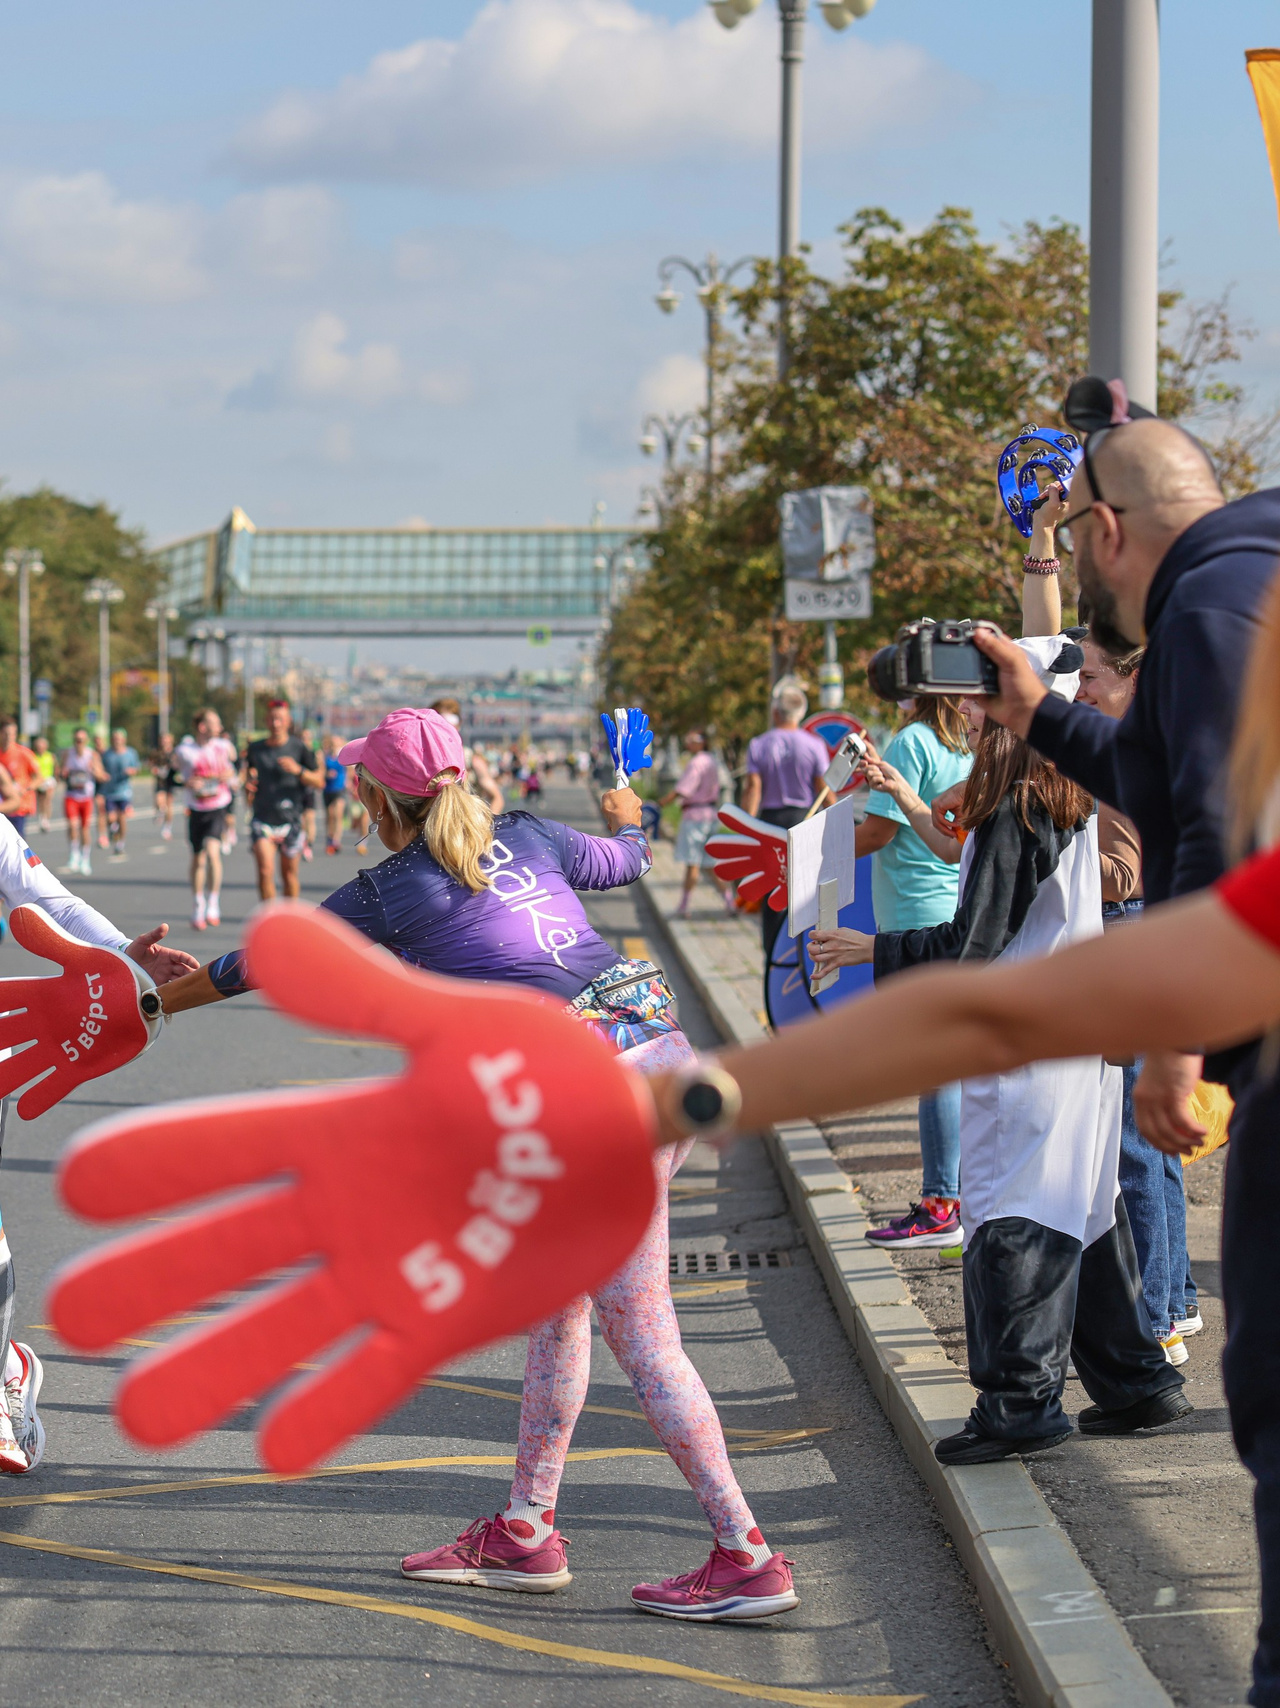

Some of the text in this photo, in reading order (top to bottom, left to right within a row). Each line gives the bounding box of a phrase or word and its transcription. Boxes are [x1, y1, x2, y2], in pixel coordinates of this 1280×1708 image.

[60, 973, 108, 1062] 5 вёрст
[400, 1049, 565, 1313] 5 вёрст
